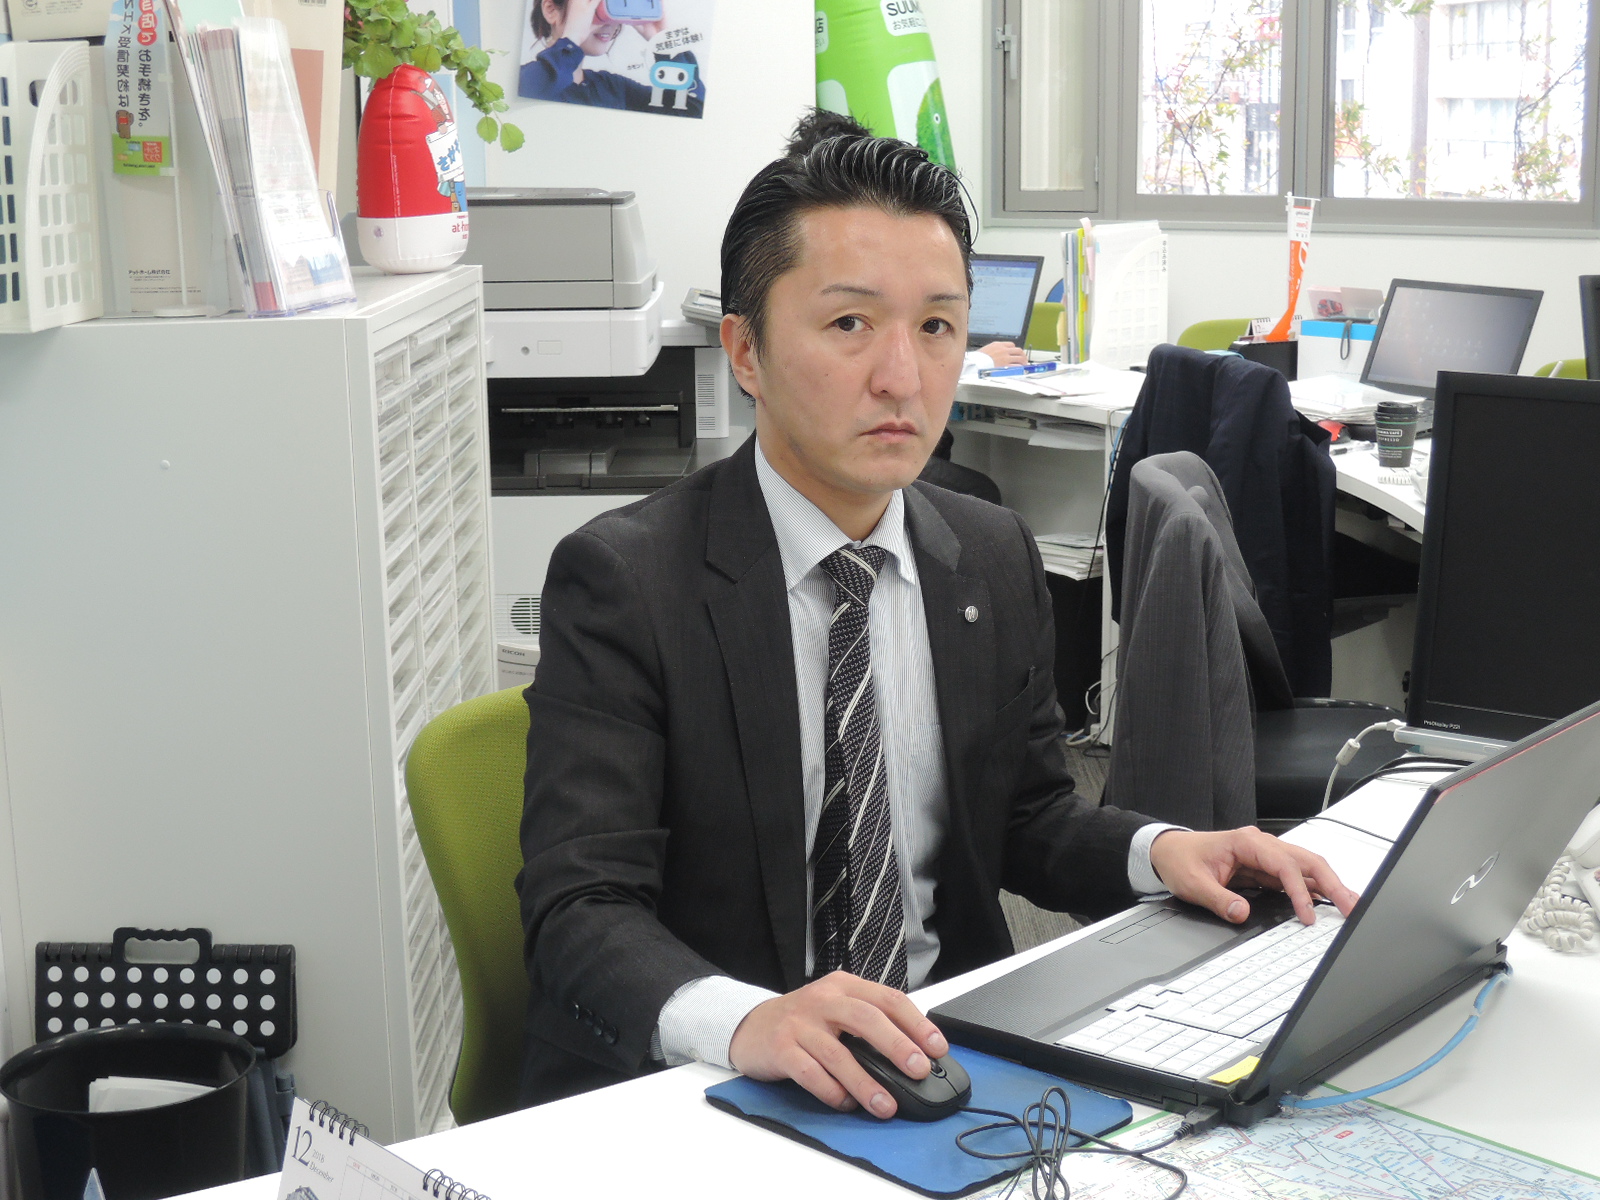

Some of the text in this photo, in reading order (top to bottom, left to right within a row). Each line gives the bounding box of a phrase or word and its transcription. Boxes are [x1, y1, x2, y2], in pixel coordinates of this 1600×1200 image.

[886, 0, 923, 16] SUUM
[665, 27, 690, 40] まずは
[291, 1125, 313, 1167] 12
[309, 1163, 334, 1183] December
